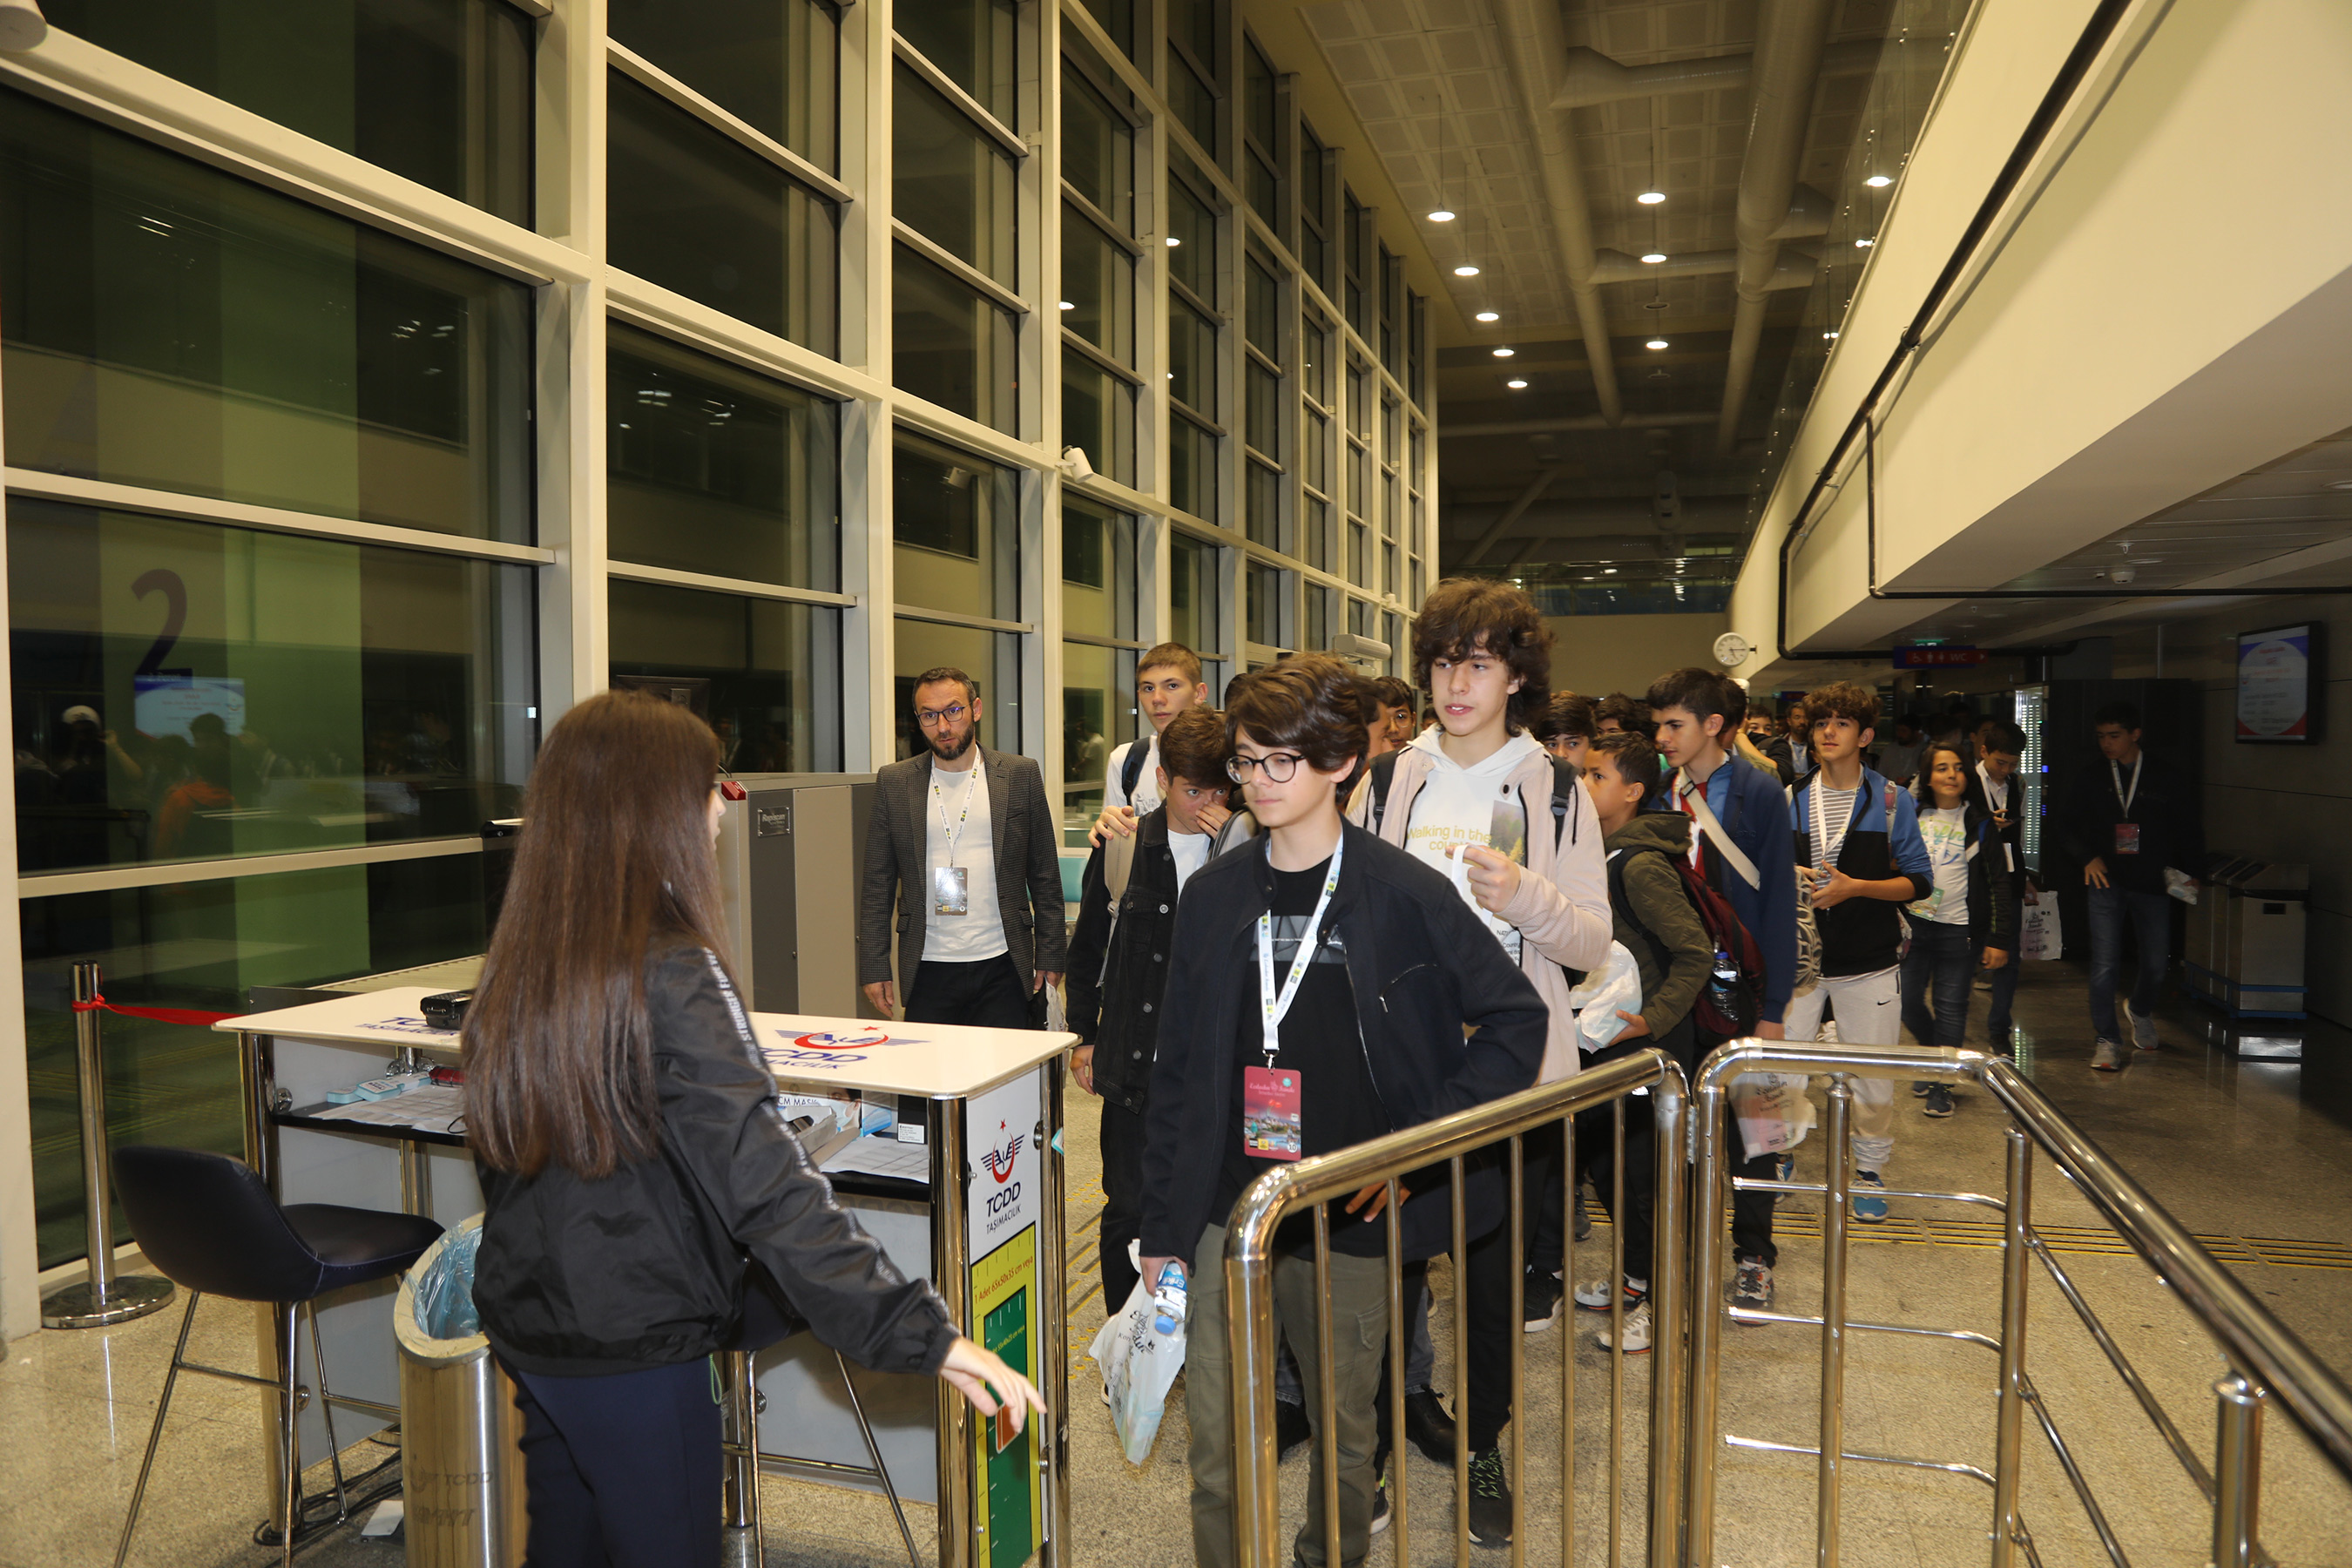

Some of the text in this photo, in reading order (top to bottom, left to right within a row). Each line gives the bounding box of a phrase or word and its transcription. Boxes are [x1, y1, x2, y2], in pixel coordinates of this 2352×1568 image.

[131, 568, 193, 689] 2
[1950, 652, 1967, 662] WC
[1406, 825, 1492, 844] Walking in the
[986, 1181, 1021, 1217] TCDD
[986, 1204, 1022, 1235] TAŞIMACILIK
[979, 1286, 991, 1301] Adet
[991, 1267, 1015, 1292] 65x50x35
[1015, 1264, 1023, 1275] cm
[1023, 1255, 1034, 1269] veya
